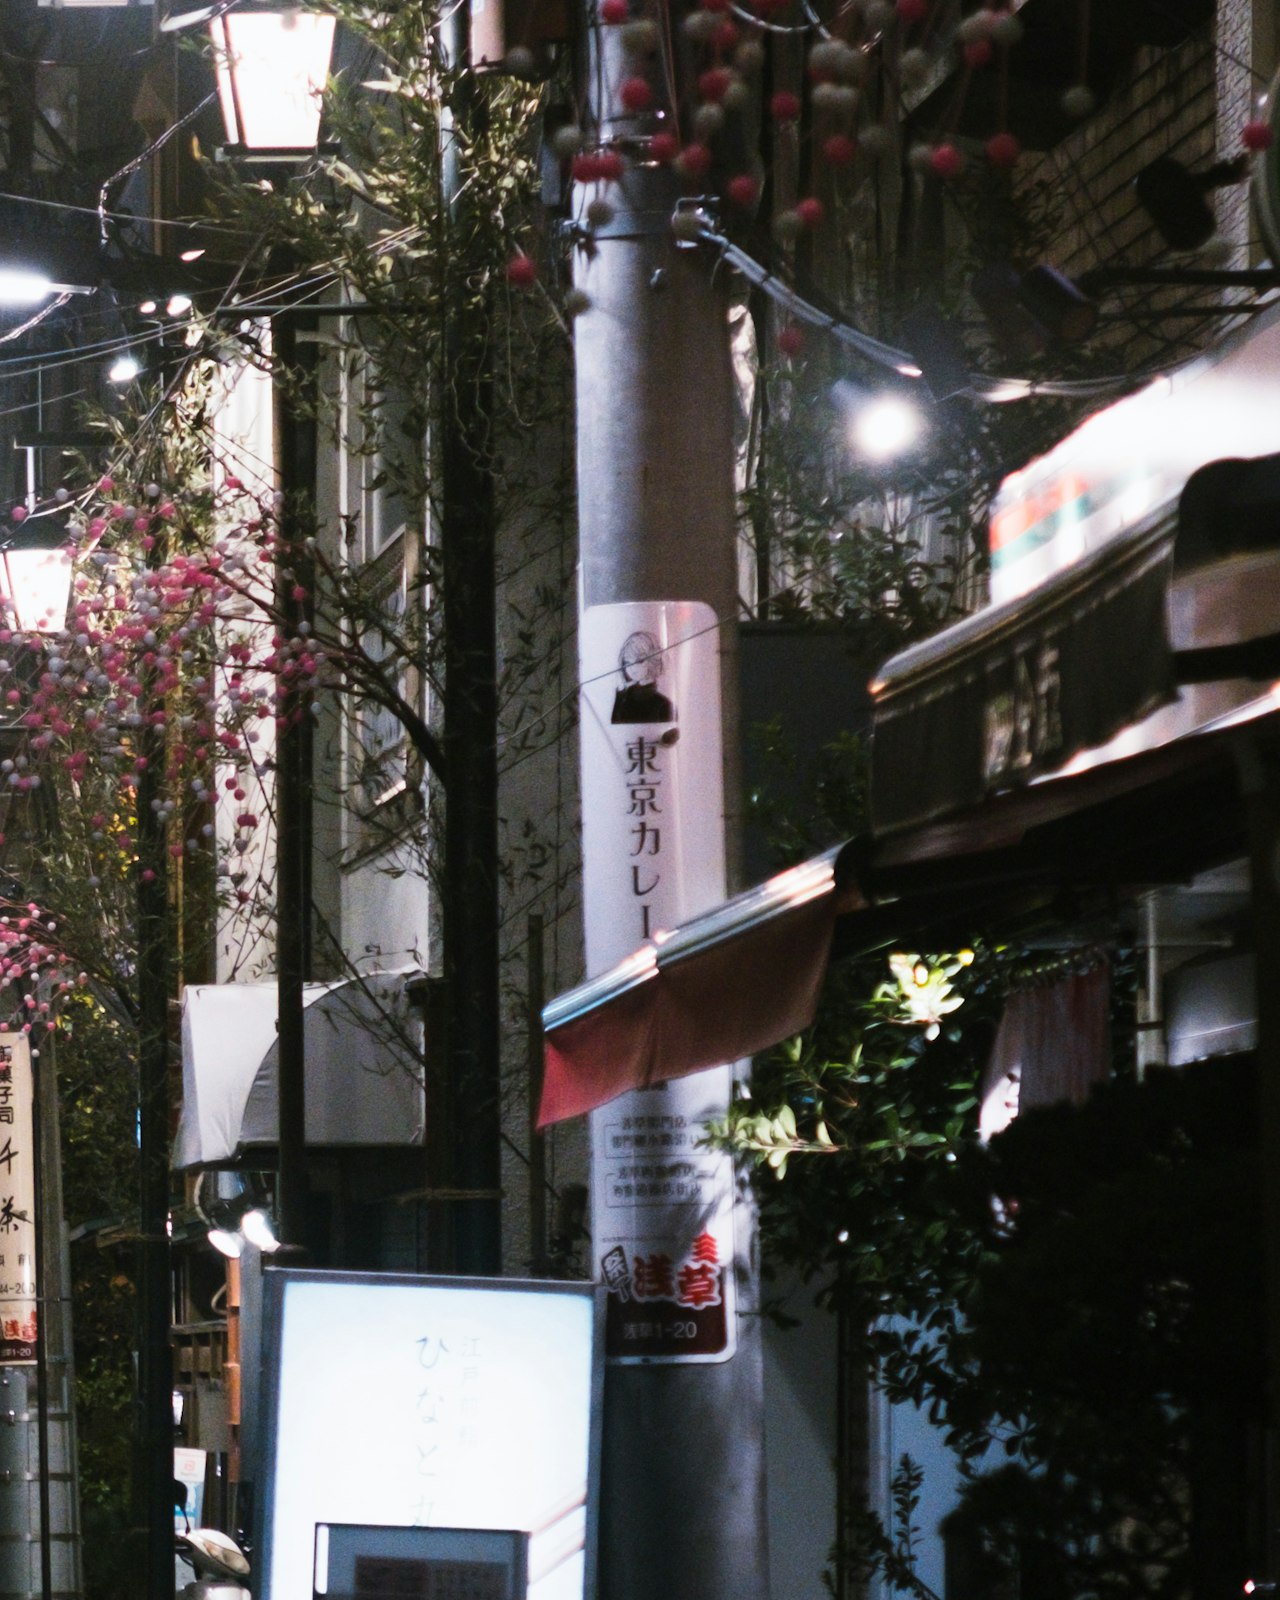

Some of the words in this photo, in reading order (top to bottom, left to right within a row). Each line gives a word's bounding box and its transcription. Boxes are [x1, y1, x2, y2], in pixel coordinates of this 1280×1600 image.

[626, 736, 663, 939] 東京カレー
[633, 1254, 719, 1308] 浅草
[623, 1321, 698, 1340] 浅草1-20
